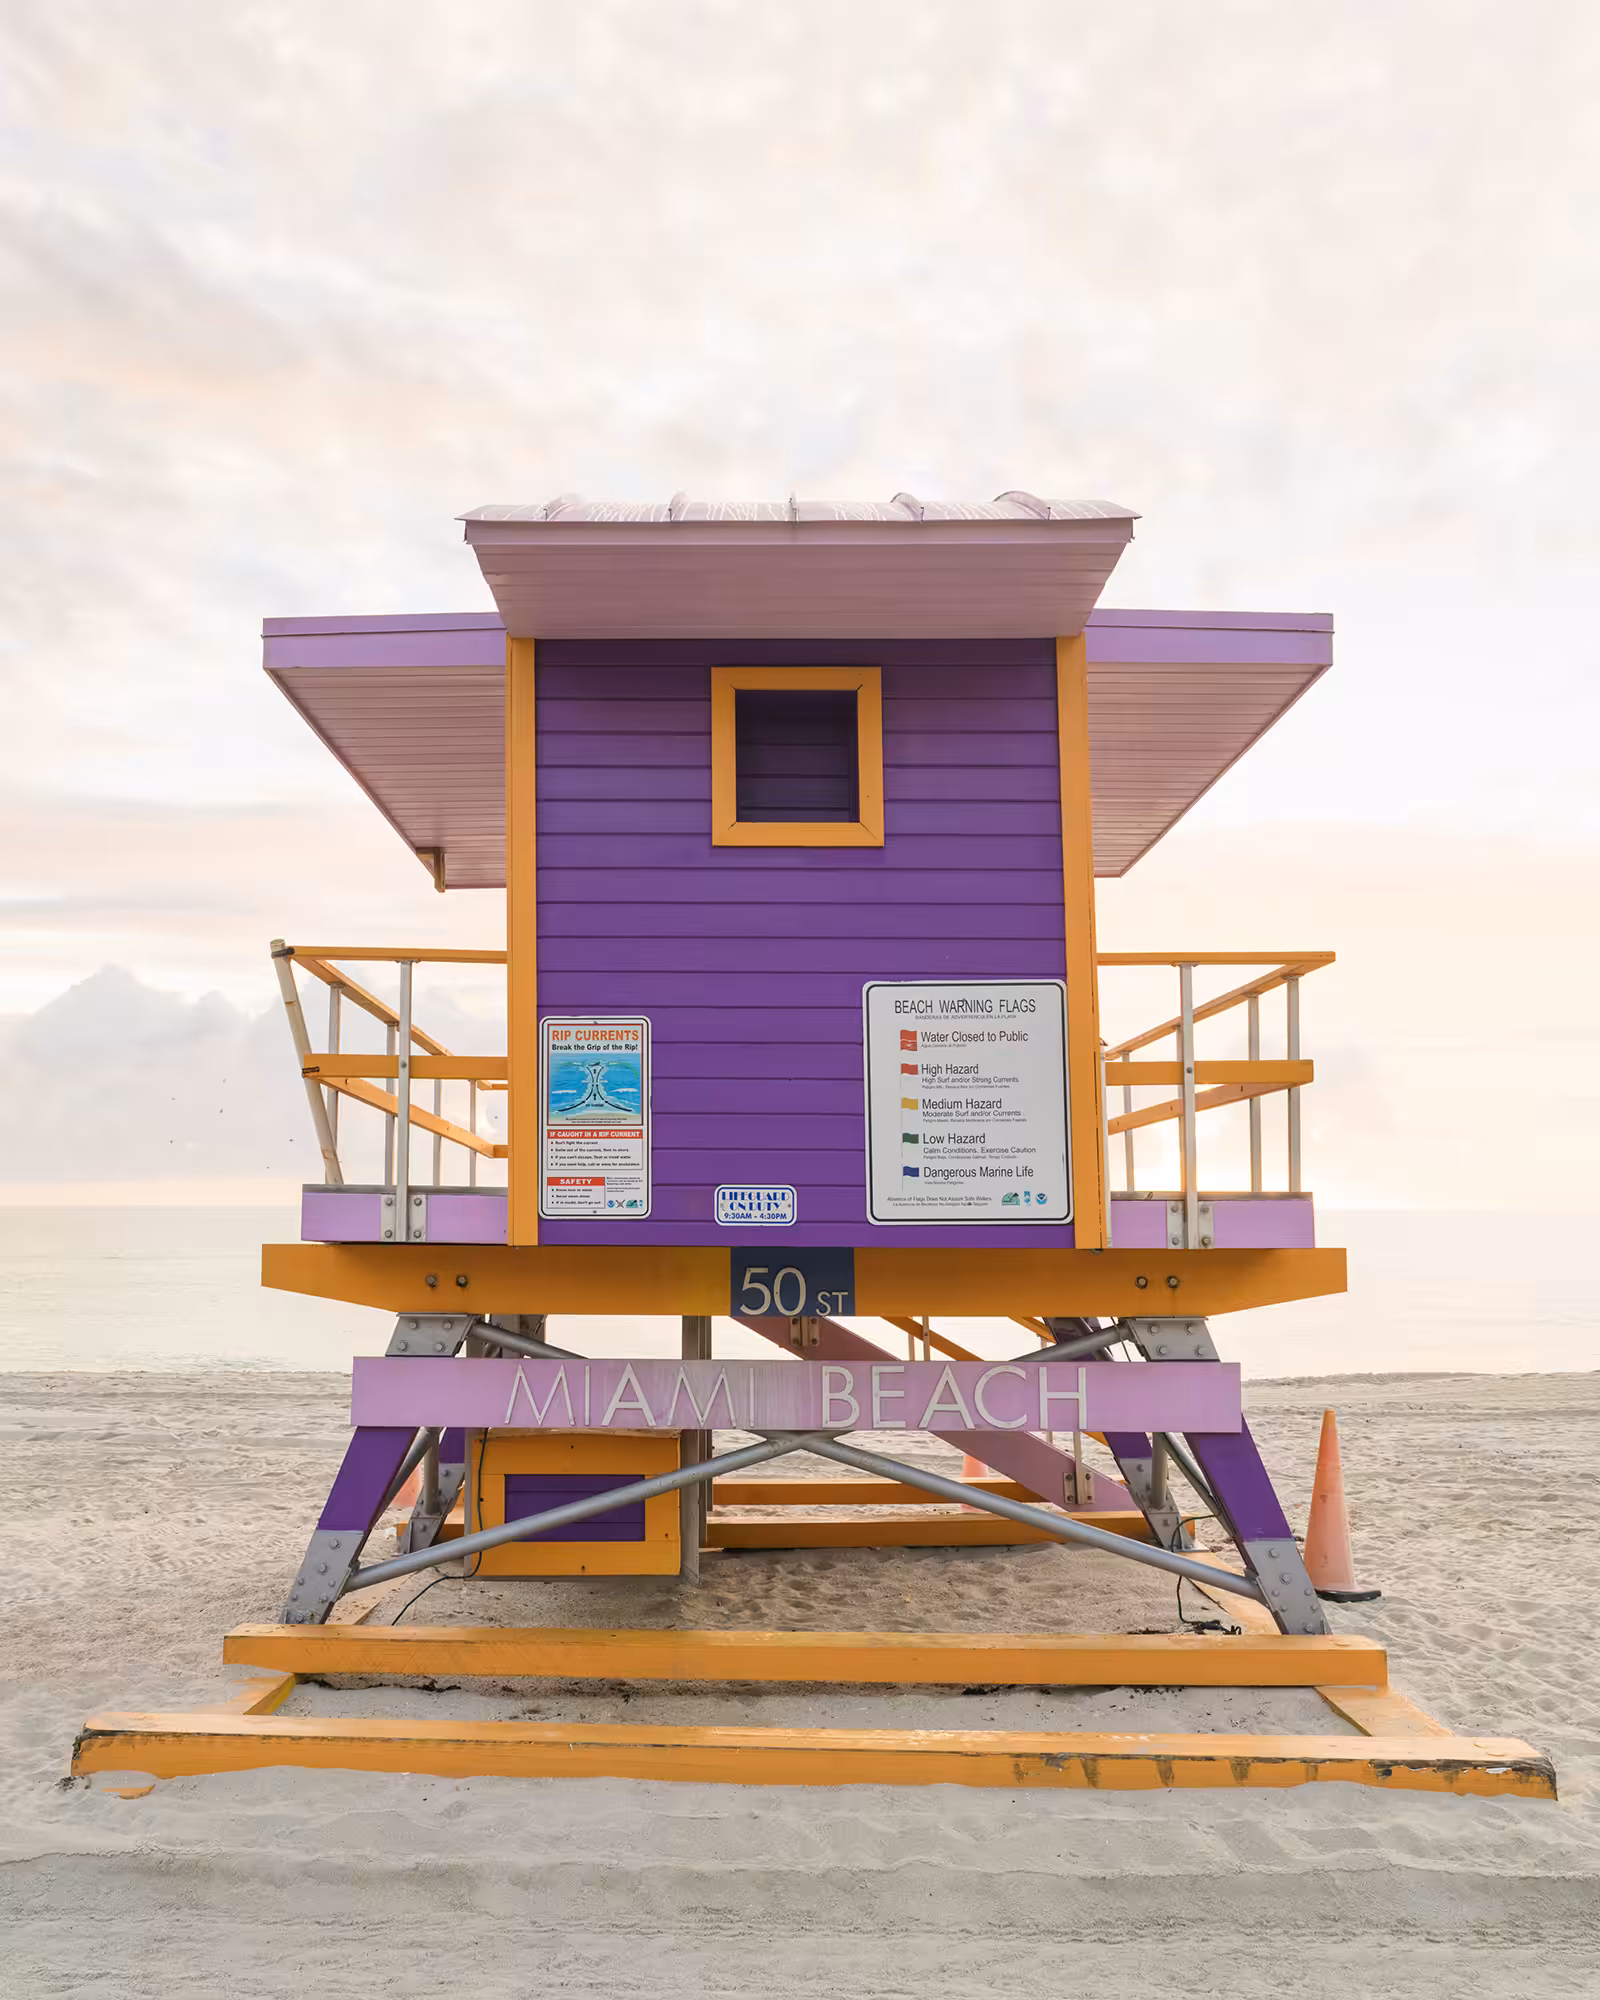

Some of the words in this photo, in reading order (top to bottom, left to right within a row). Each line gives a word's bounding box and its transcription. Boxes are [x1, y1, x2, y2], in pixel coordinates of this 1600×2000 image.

[894, 1000, 933, 1014] BEACH
[938, 1000, 993, 1013] WARNING
[999, 999, 1036, 1013] FLAGS
[552, 1030, 571, 1040] RIP
[575, 1030, 639, 1040] CURRENTS
[921, 1032, 949, 1042] Water
[952, 1031, 985, 1042] Closed
[988, 1032, 996, 1042] to
[999, 1031, 1028, 1041] Public
[921, 1064, 942, 1077] High
[946, 1064, 979, 1074] Hazard
[922, 1098, 962, 1109] Medium
[966, 1098, 1002, 1109] Hazard
[923, 1133, 945, 1144] Low
[948, 1133, 986, 1144] Hazard
[924, 1166, 976, 1180] Dangerous
[980, 1166, 1013, 1177] Marine
[1016, 1166, 1034, 1177] Life
[722, 1192, 790, 1200] LIFEGUARD
[730, 1202, 746, 1211] ON
[749, 1202, 782, 1211] DUTY
[740, 1266, 806, 1316] 50
[816, 1291, 848, 1316] ST
[504, 1362, 754, 1427] MIAMI
[821, 1363, 1086, 1430] BEACH
